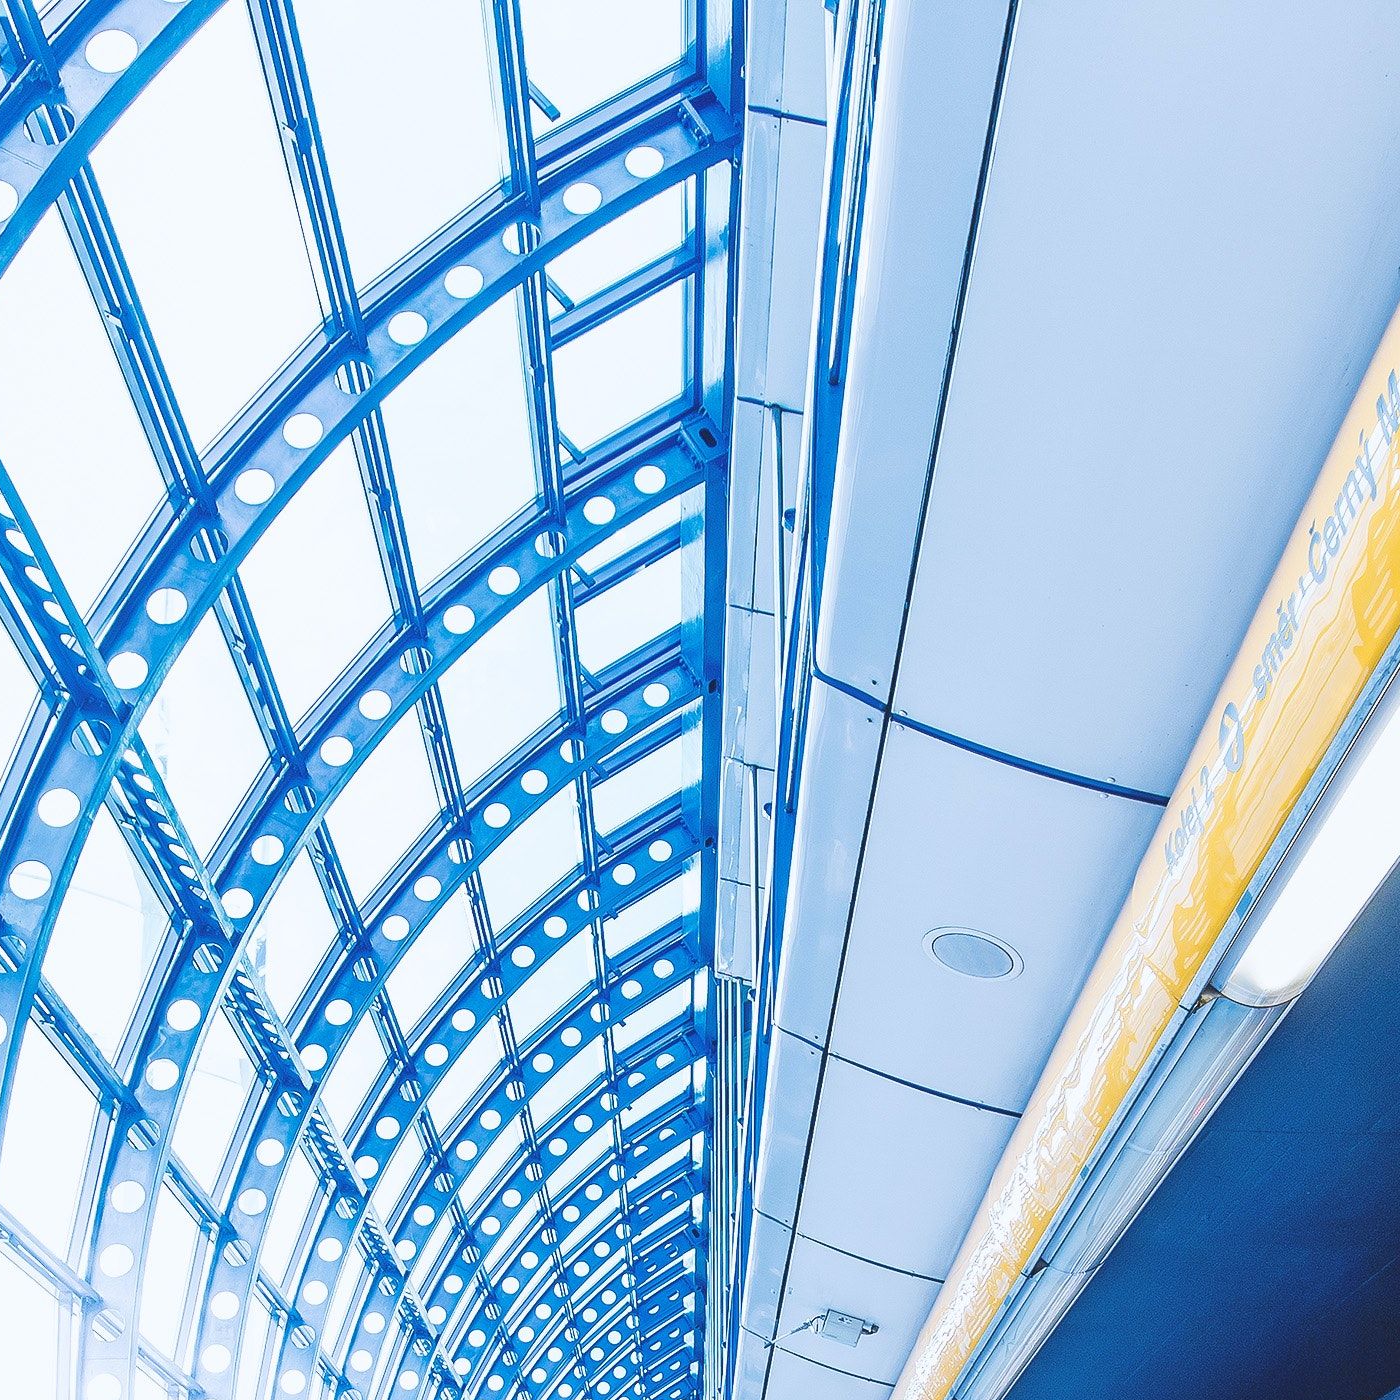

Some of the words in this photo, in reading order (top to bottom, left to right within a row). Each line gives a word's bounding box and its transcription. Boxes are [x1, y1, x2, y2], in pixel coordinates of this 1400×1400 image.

[1163, 803, 1206, 876] Kolej
[1198, 765, 1215, 802] 2
[1308, 427, 1379, 585] Černý
